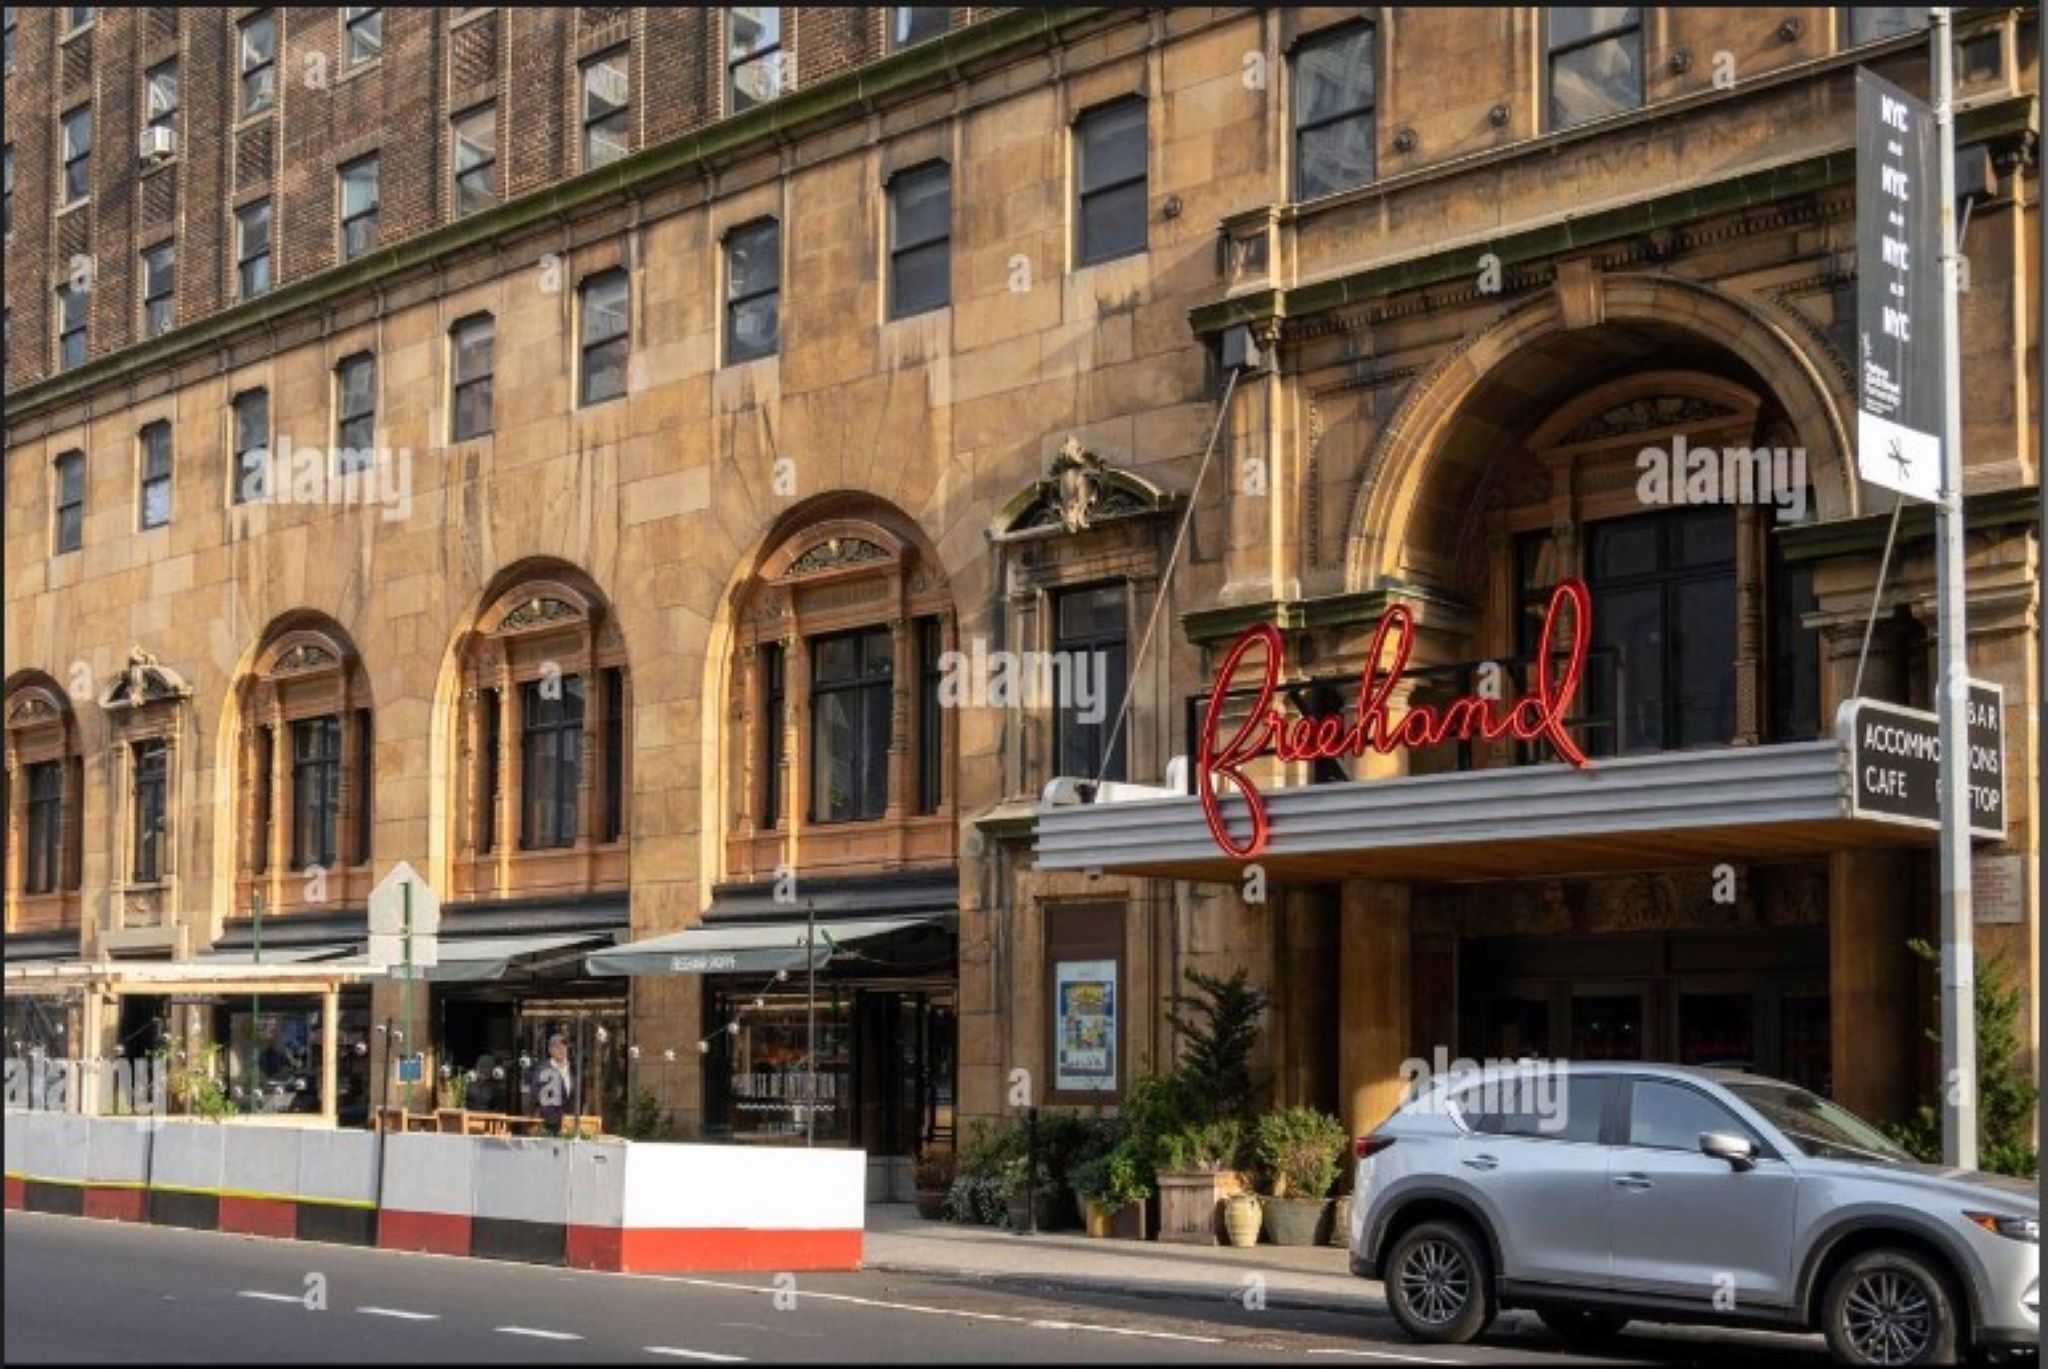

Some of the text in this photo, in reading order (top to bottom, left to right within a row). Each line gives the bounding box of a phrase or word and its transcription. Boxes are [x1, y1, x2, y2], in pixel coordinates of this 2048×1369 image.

[1882, 94, 1909, 132] NYC
[1882, 163, 1910, 201] NYC
[1882, 234, 1910, 271] NYC
[1883, 306, 1910, 342] NYC
[1199, 579, 1592, 859] freehand
[1967, 701, 1997, 731] BAR
[1864, 722, 1998, 775] ACCOMMOONS
[1865, 764, 1907, 798] CAFE
